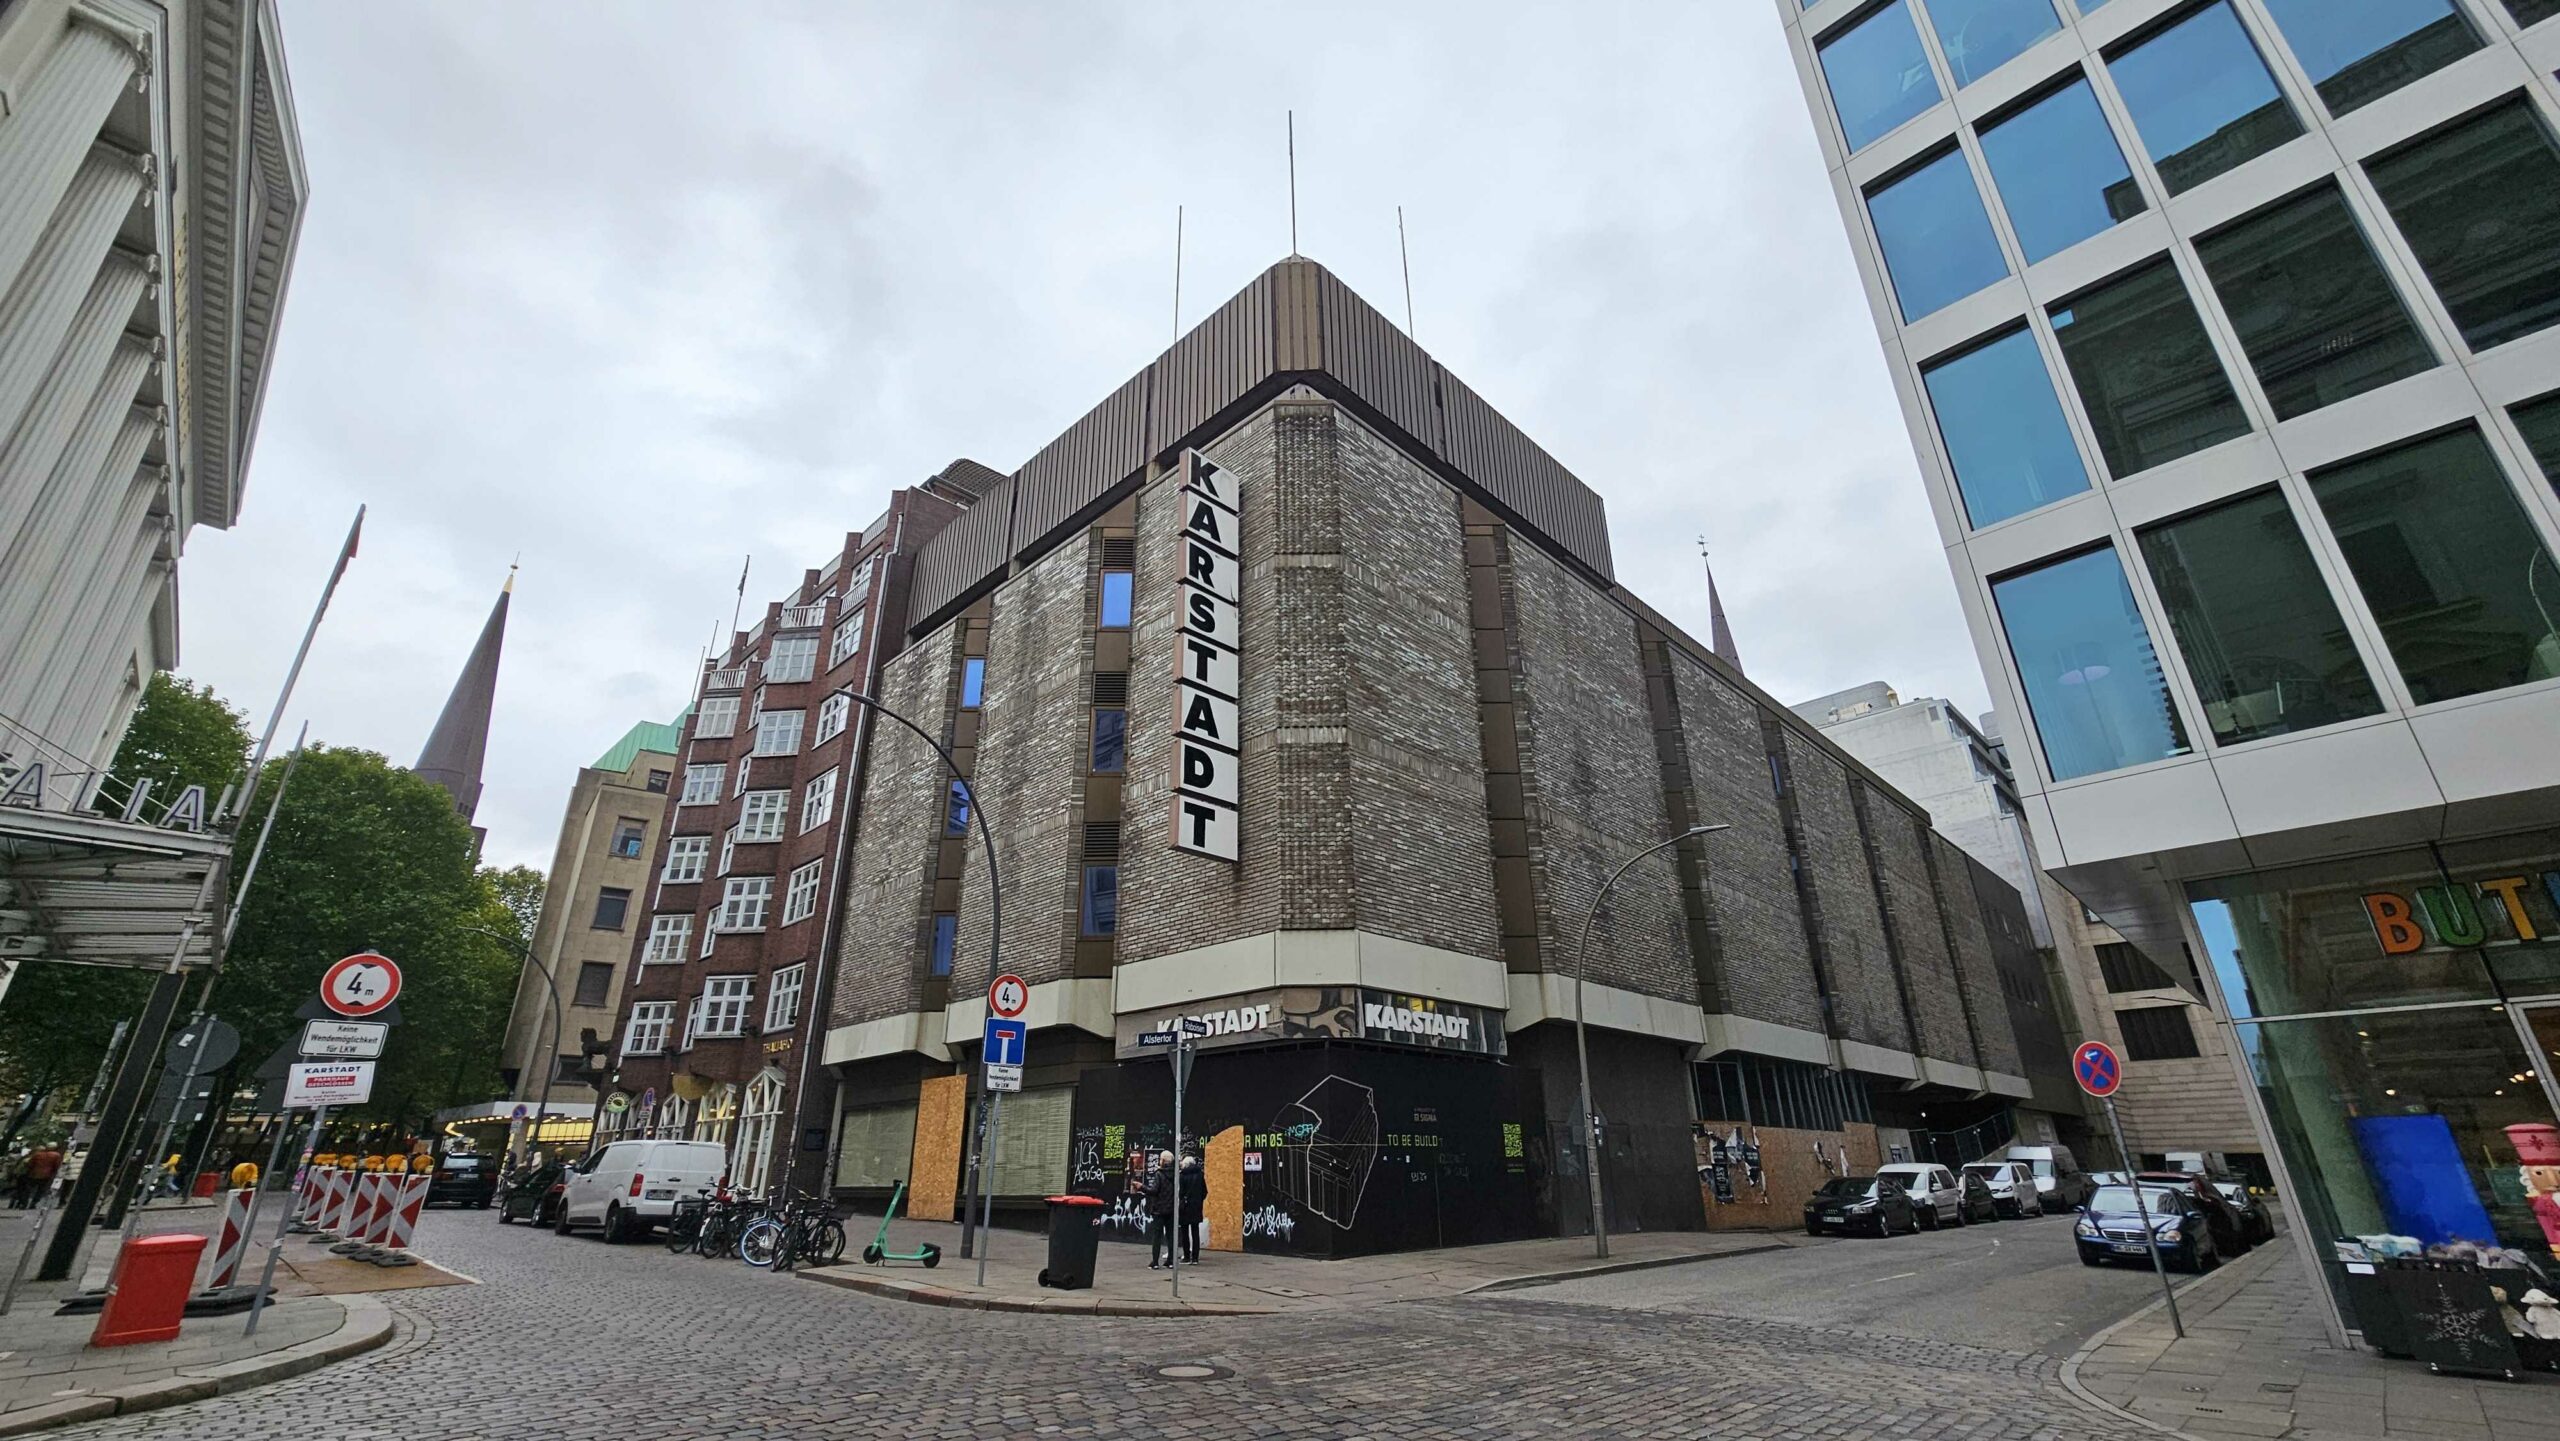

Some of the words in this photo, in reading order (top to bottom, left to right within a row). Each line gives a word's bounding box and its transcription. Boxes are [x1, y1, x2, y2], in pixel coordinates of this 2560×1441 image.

[1184, 451, 1221, 849] KARSTADT
[347, 972, 363, 995] 4
[364, 988, 374, 996] m
[1002, 987, 1010, 1004] 4
[1364, 1003, 1469, 1040] KARSTADT
[337, 1025, 359, 1033] Keine
[310, 1033, 379, 1045] Wendemöglichkeit
[1143, 1034, 1173, 1044] Alstertor
[326, 1045, 338, 1053] für
[304, 1066, 362, 1074] KARSTADT
[1387, 1134, 1399, 1146] TO
[1402, 1134, 1412, 1146] BE
[1414, 1135, 1438, 1147] BUILD
